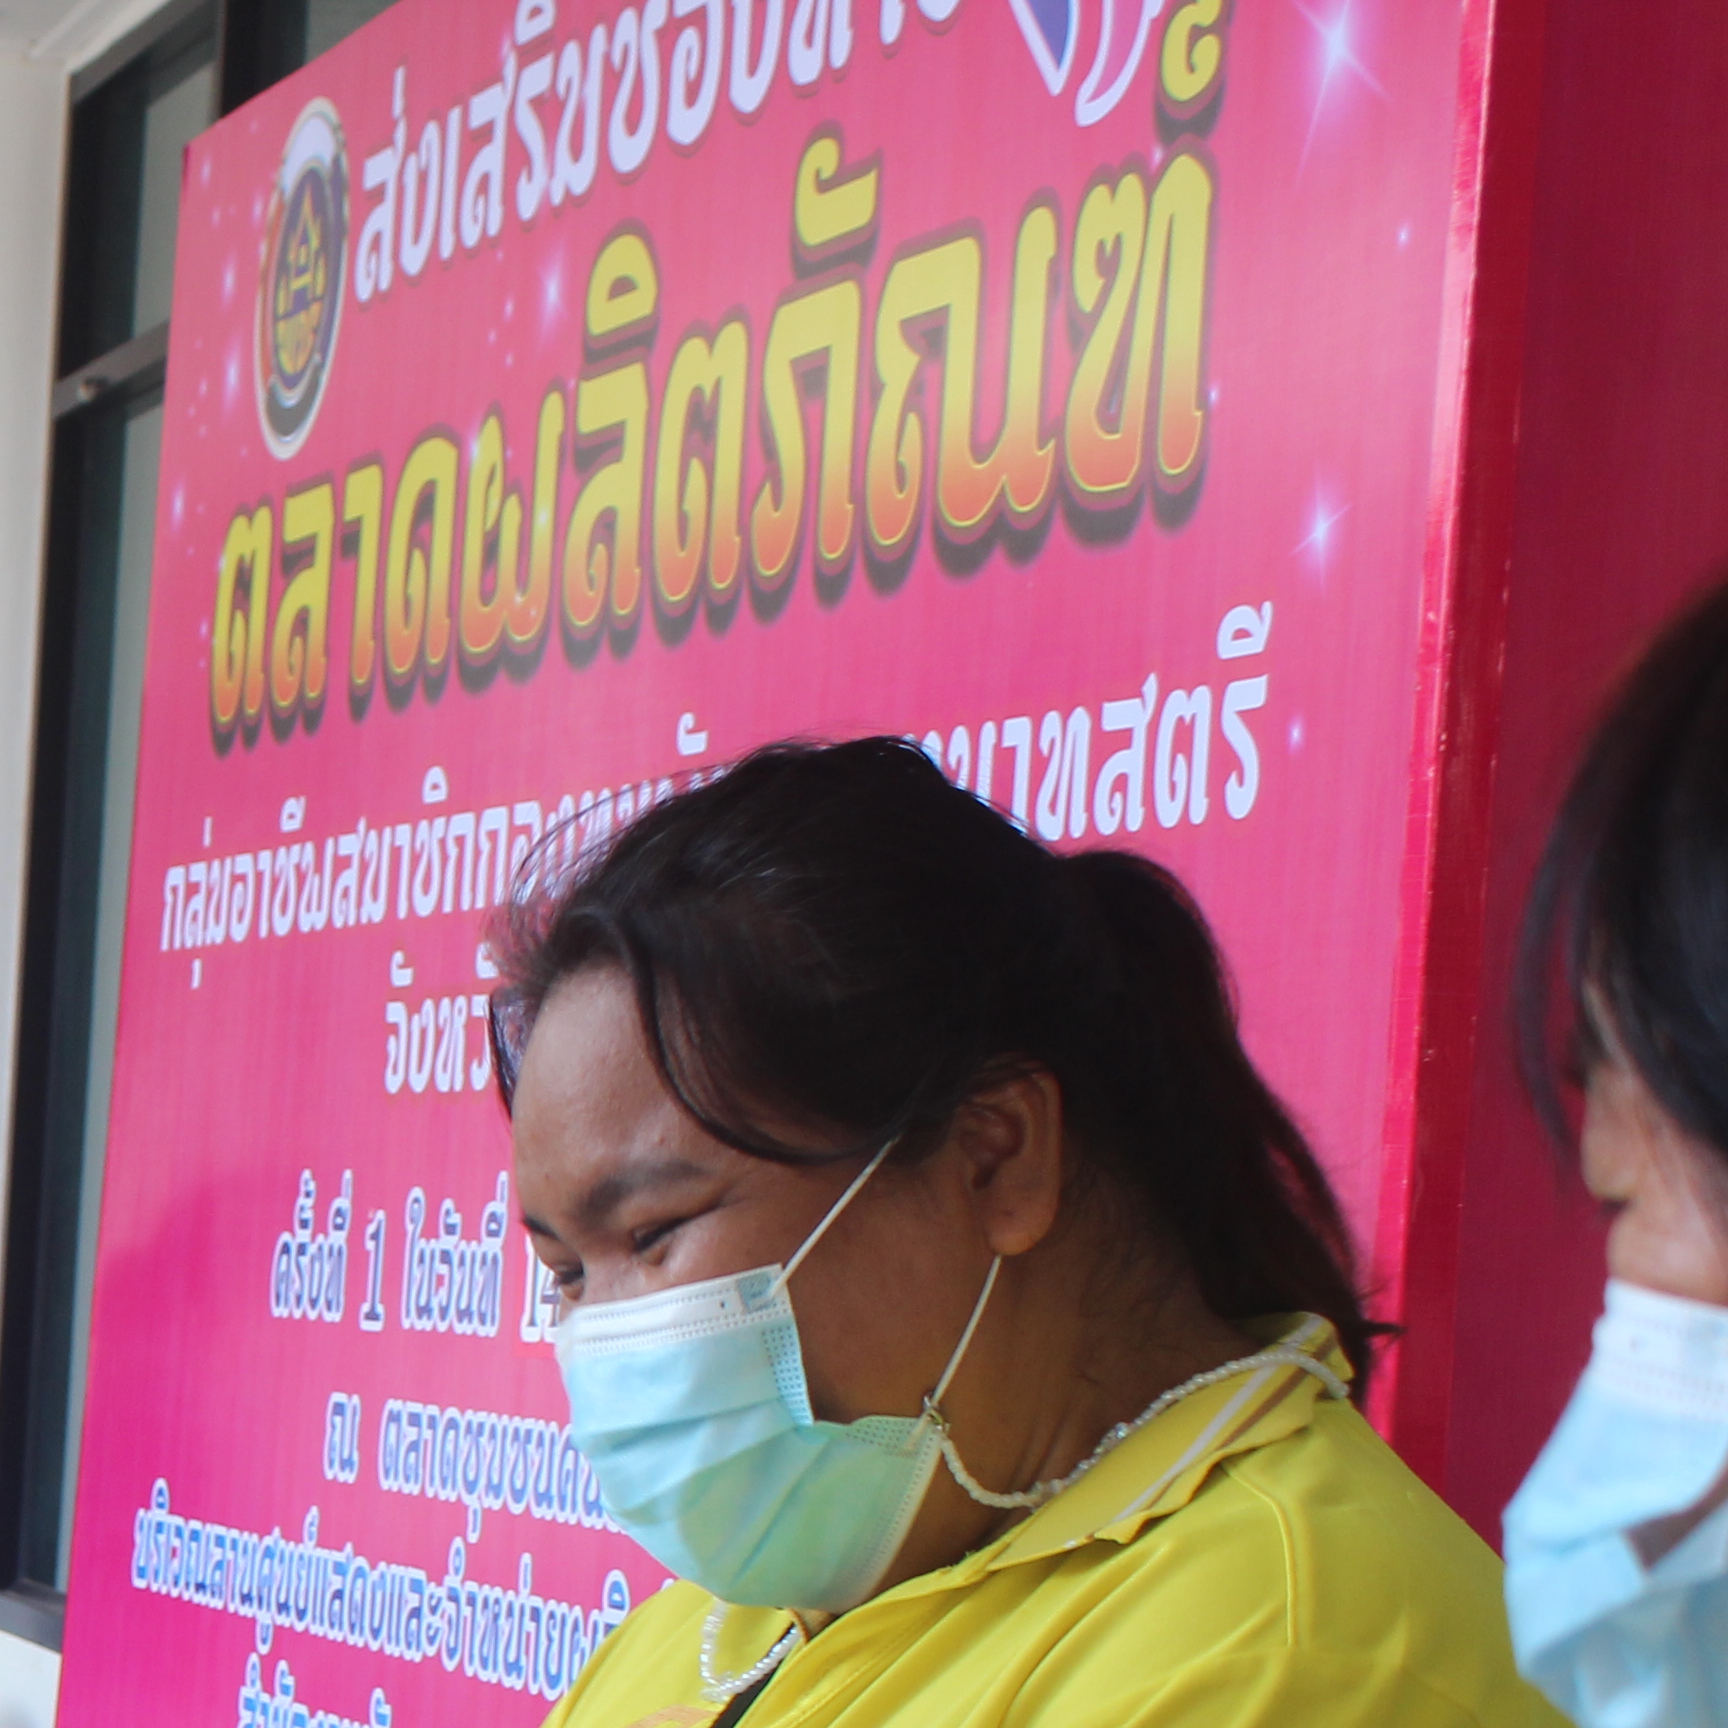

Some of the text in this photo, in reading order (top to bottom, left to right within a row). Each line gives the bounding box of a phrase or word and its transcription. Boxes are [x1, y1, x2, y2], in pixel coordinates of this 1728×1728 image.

[208, 0, 1224, 728] ตลาดผลิตภัณฑ์
[270, 1168, 352, 1322] ครั้งที่
[359, 1209, 386, 1332] 1
[401, 1170, 508, 1338] ในวันที่
[323, 1391, 361, 1484] ณ
